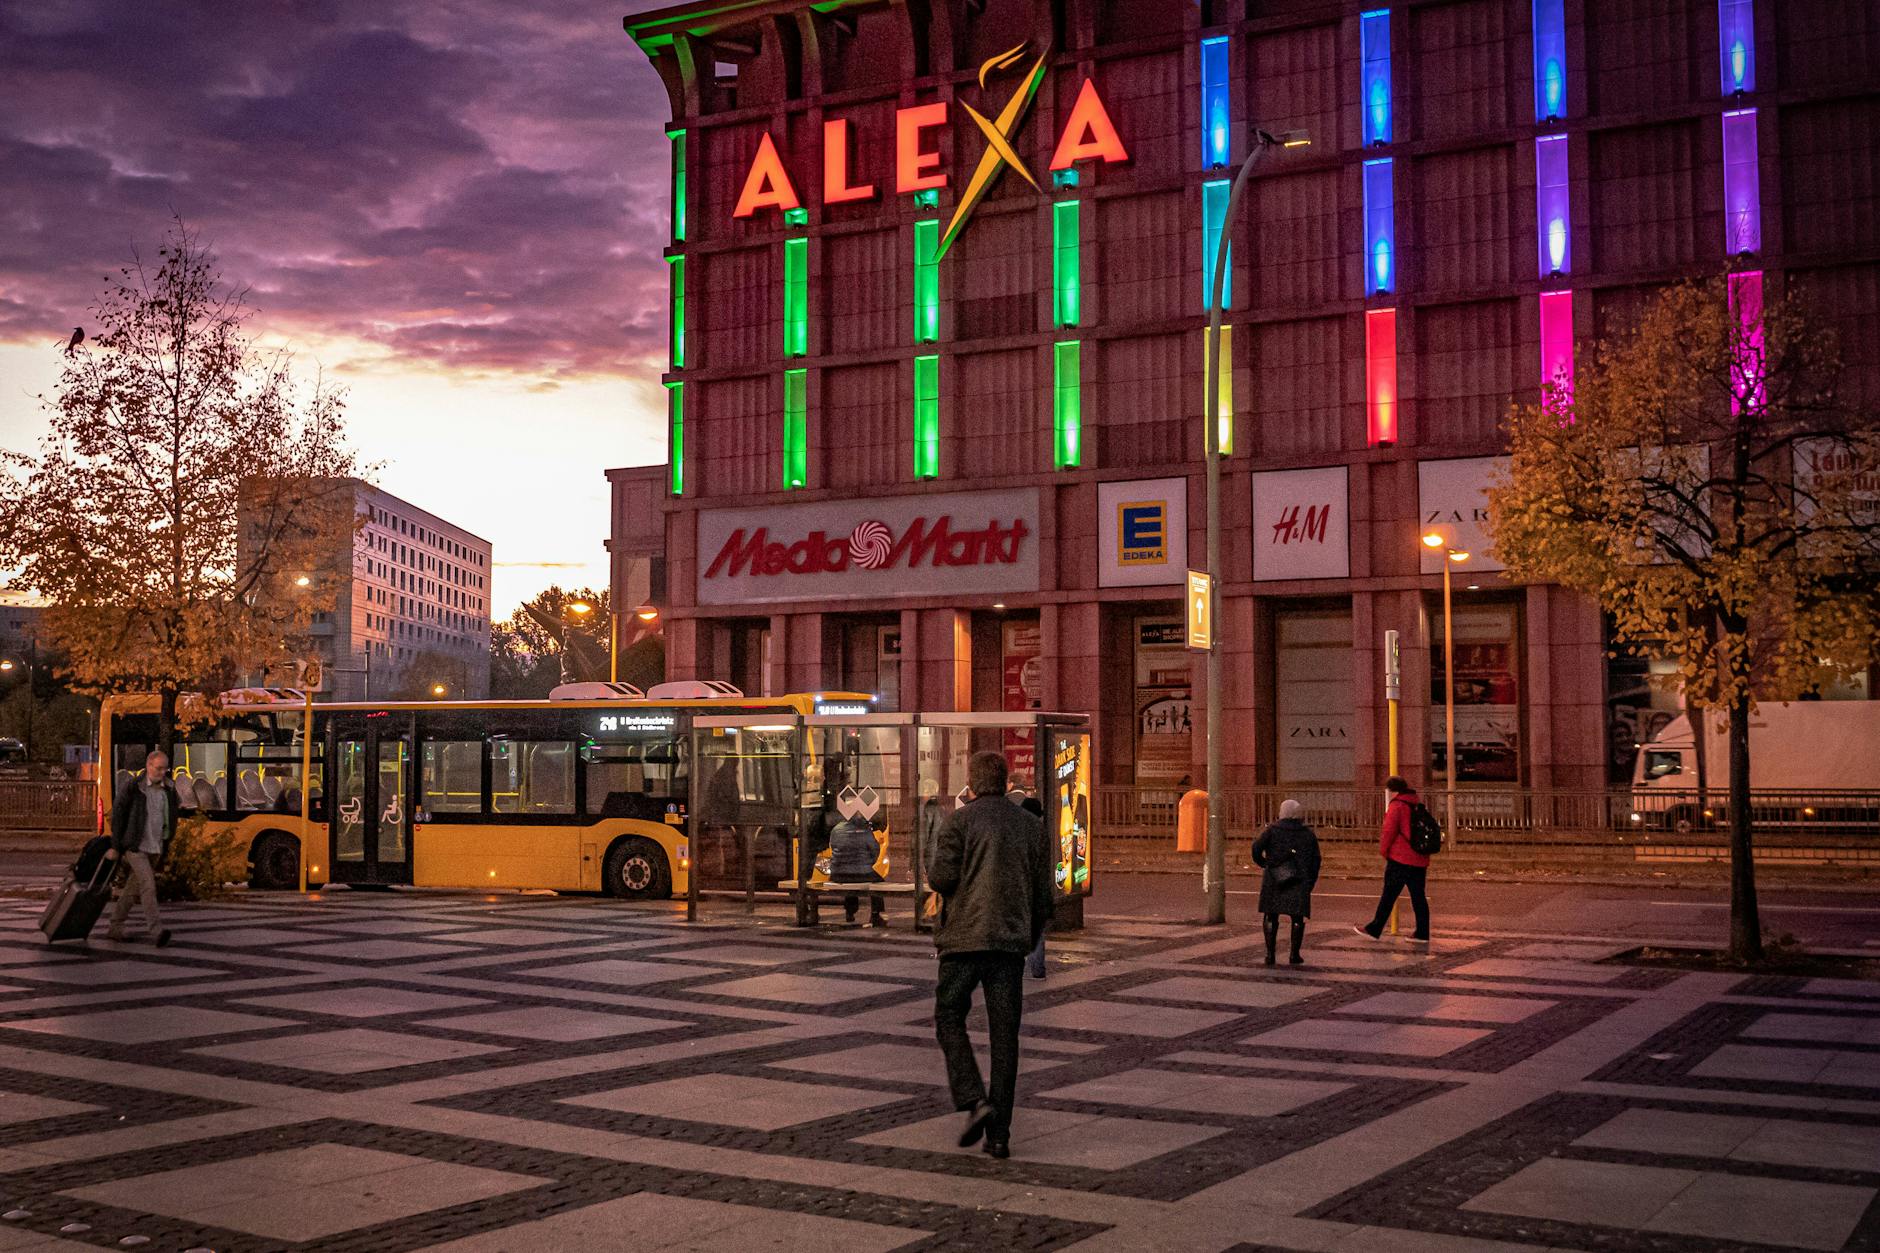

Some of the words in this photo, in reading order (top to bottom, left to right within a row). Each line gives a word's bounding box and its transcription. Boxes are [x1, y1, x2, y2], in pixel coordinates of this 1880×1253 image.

[732, 40, 1129, 264] ALEXA
[1123, 506, 1162, 549] E
[1271, 503, 1330, 545] H&M
[1425, 508, 1490, 523] ZAR
[703, 527, 850, 579] Media
[885, 515, 1029, 570] Markt
[1123, 551, 1163, 560] EDEKA
[1290, 727, 1347, 737] ZARA
